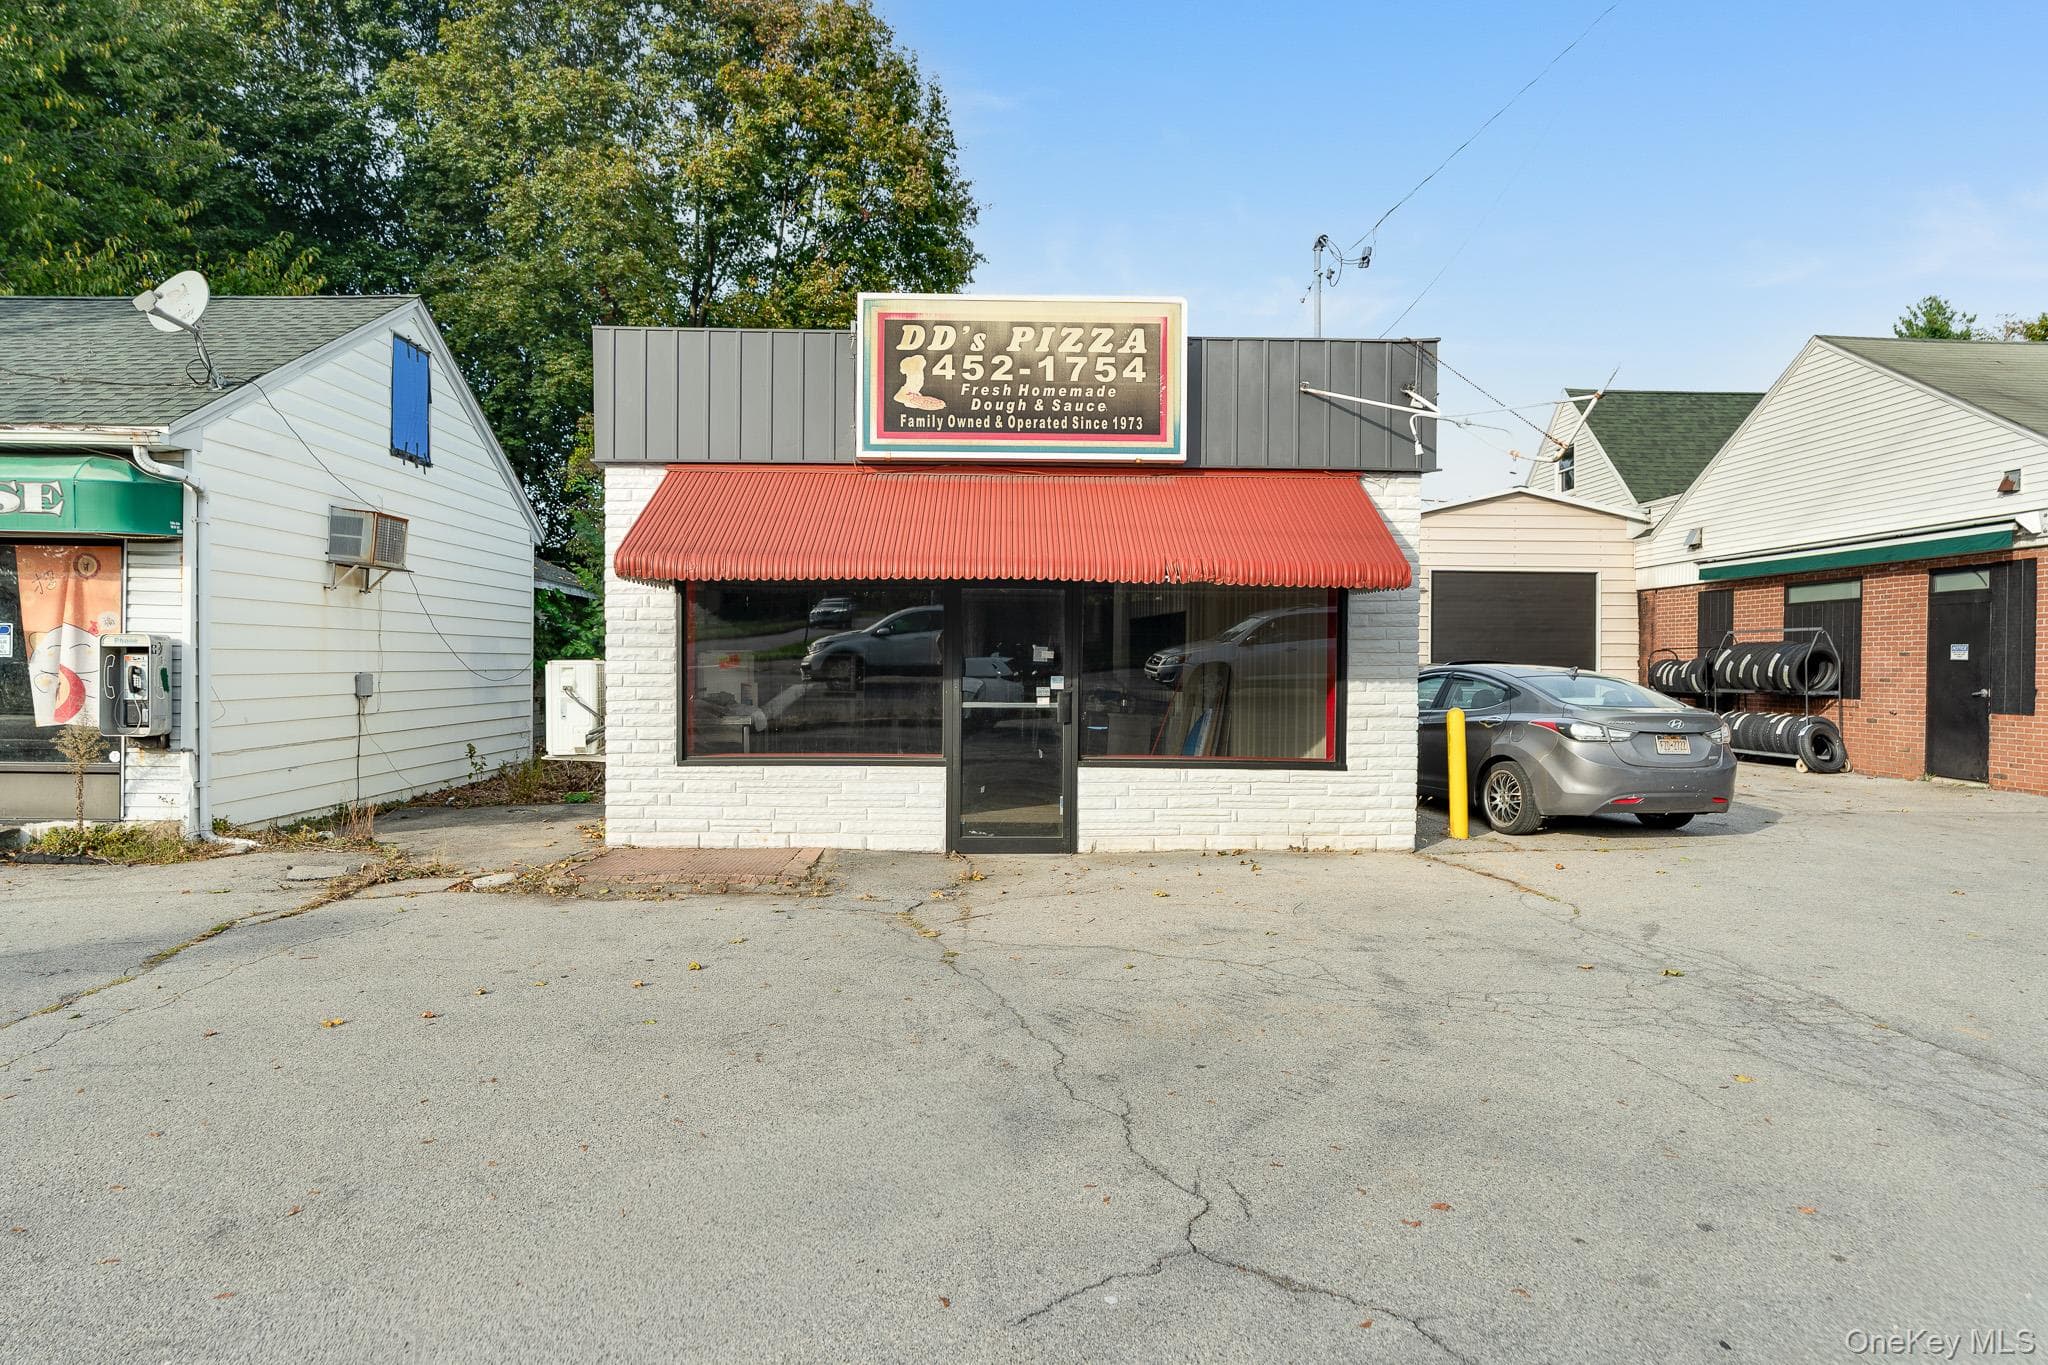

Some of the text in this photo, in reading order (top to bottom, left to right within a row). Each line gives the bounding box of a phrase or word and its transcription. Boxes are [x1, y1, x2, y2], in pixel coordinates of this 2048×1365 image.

[896, 324, 1148, 354] DD's PIZZA
[932, 354, 1147, 383] 452-1754
[960, 383, 1117, 398] Fresh Homemade
[971, 398, 1107, 414] Dough & Sauce
[900, 414, 1143, 432] Family Owned & Operated Since 1973
